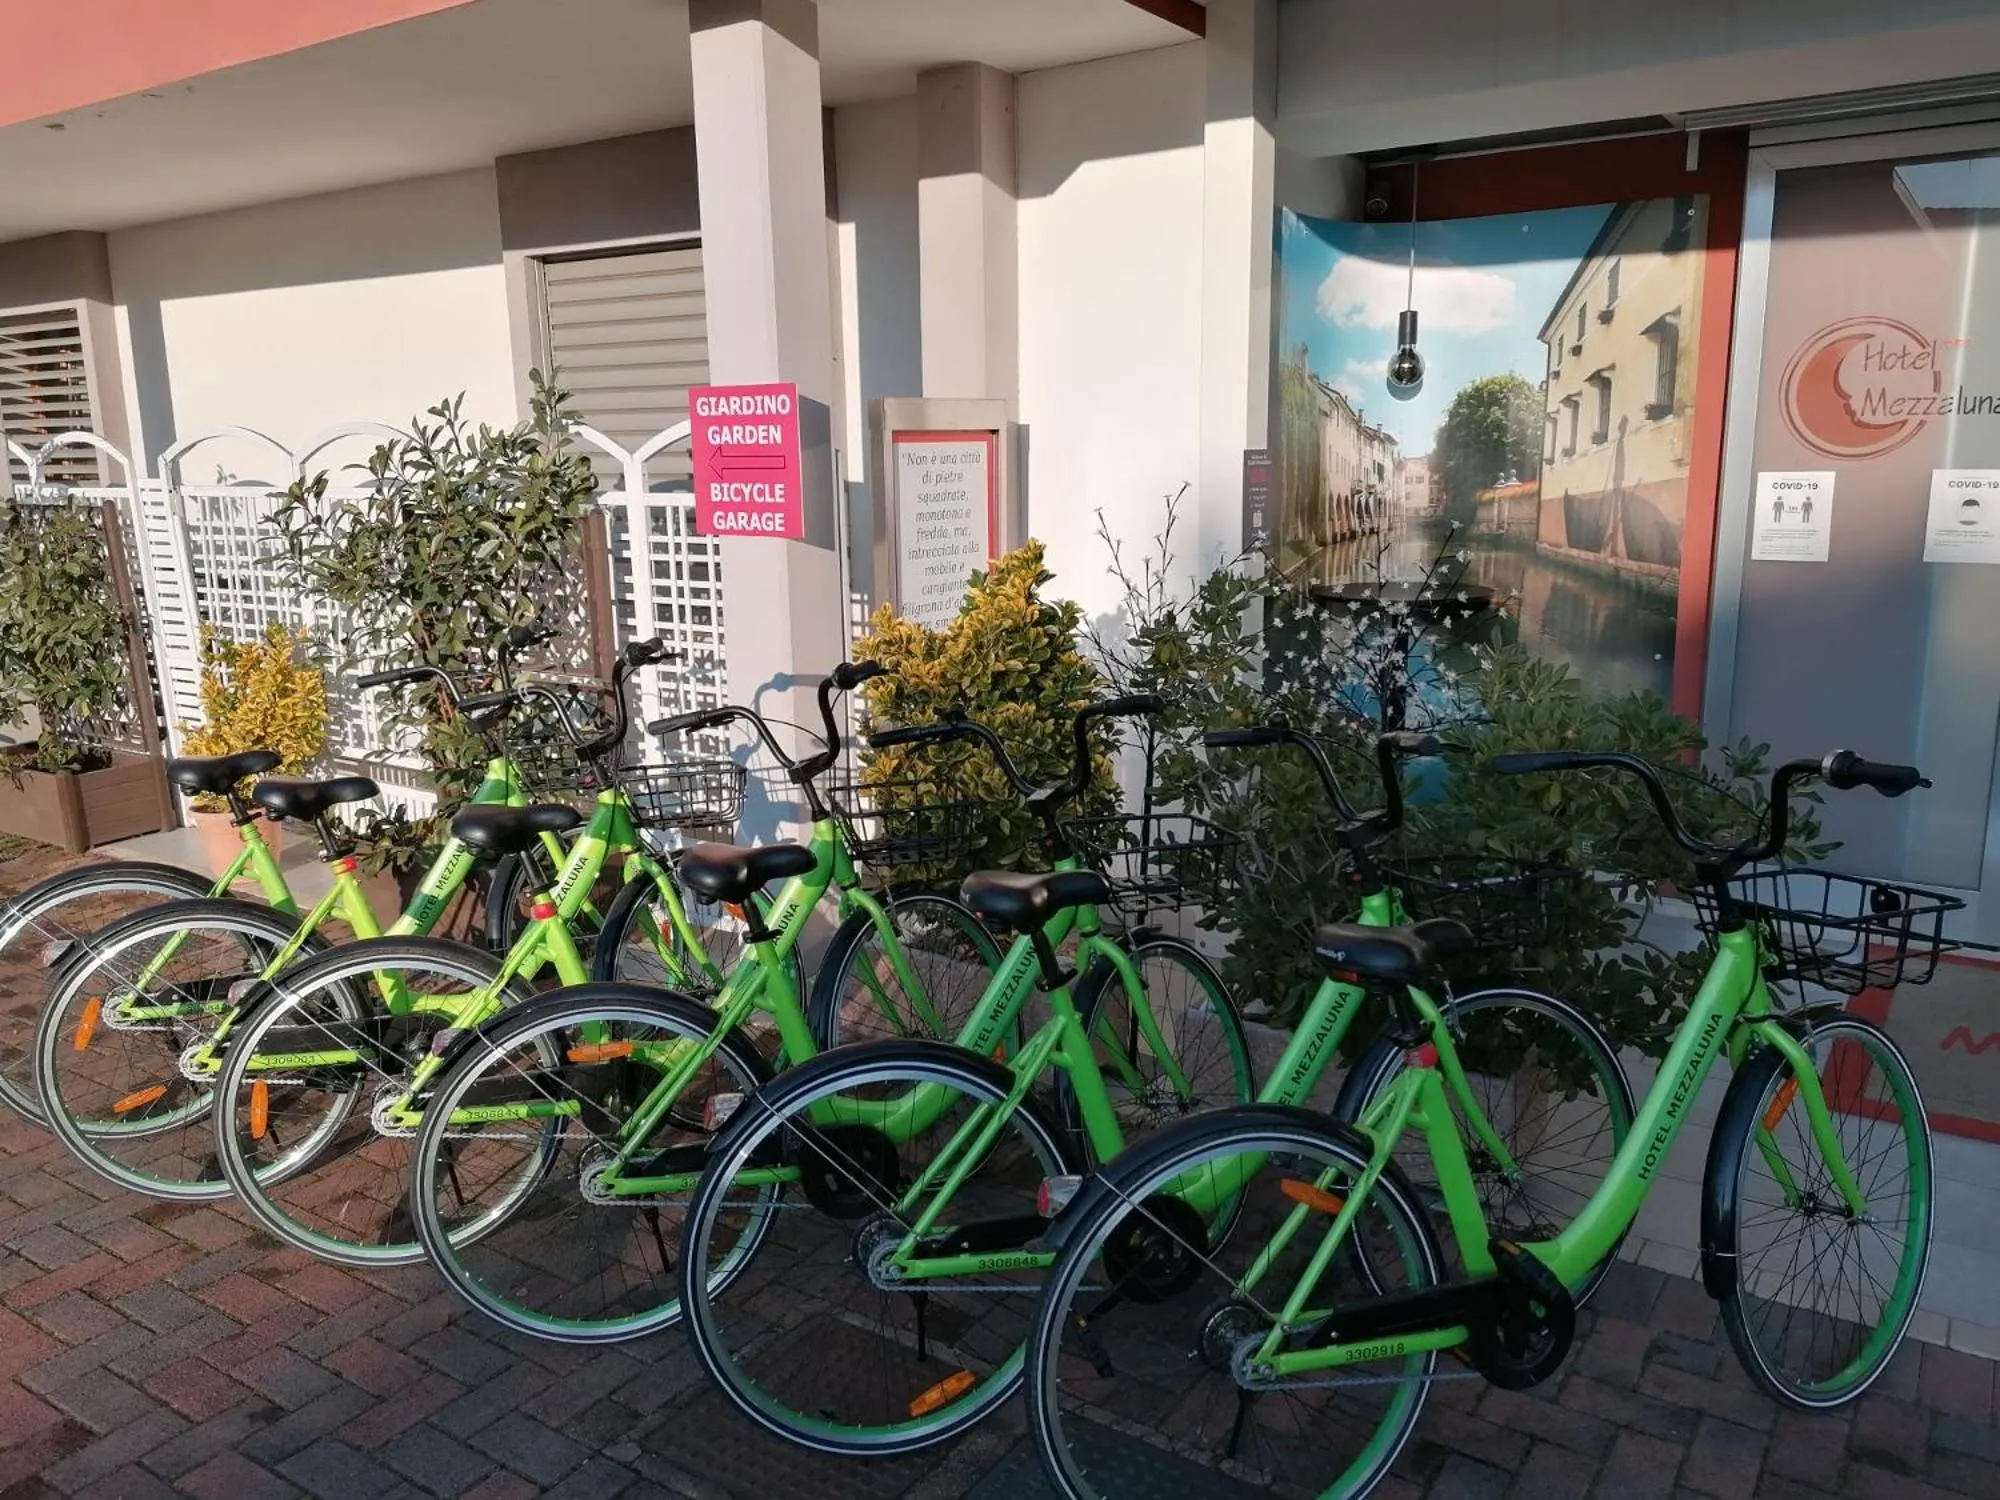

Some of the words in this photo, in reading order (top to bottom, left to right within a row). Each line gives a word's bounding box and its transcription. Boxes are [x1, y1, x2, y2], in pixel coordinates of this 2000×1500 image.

[1862, 340, 1937, 372] Hotel
[696, 394, 790, 417] GIARDINO
[708, 425, 782, 444] GARDEN
[940, 453, 958, 465] una
[960, 449, 982, 464] città
[922, 471, 932, 484] di
[935, 470, 964, 486] pietre
[1771, 482, 1818, 490] COVID-19
[1948, 481, 2000, 489] COVID-19
[710, 482, 785, 503] BICYCLE
[713, 511, 785, 531] GARAGE
[915, 508, 964, 523] monotona
[964, 508, 972, 518] e
[415, 894, 439, 928] HOTEL
[435, 844, 466, 890] MEZZAL
[556, 856, 589, 906] ZALUNA
[972, 1026, 994, 1050] TEL
[989, 945, 1036, 1022] MEZZALUN
[1290, 990, 1351, 1086] MEZZALUNA
[1637, 1123, 1671, 1181] HOTEL
[1665, 1013, 1723, 1119] MEZZALUNA
[1345, 1342, 1405, 1361] 3302918
